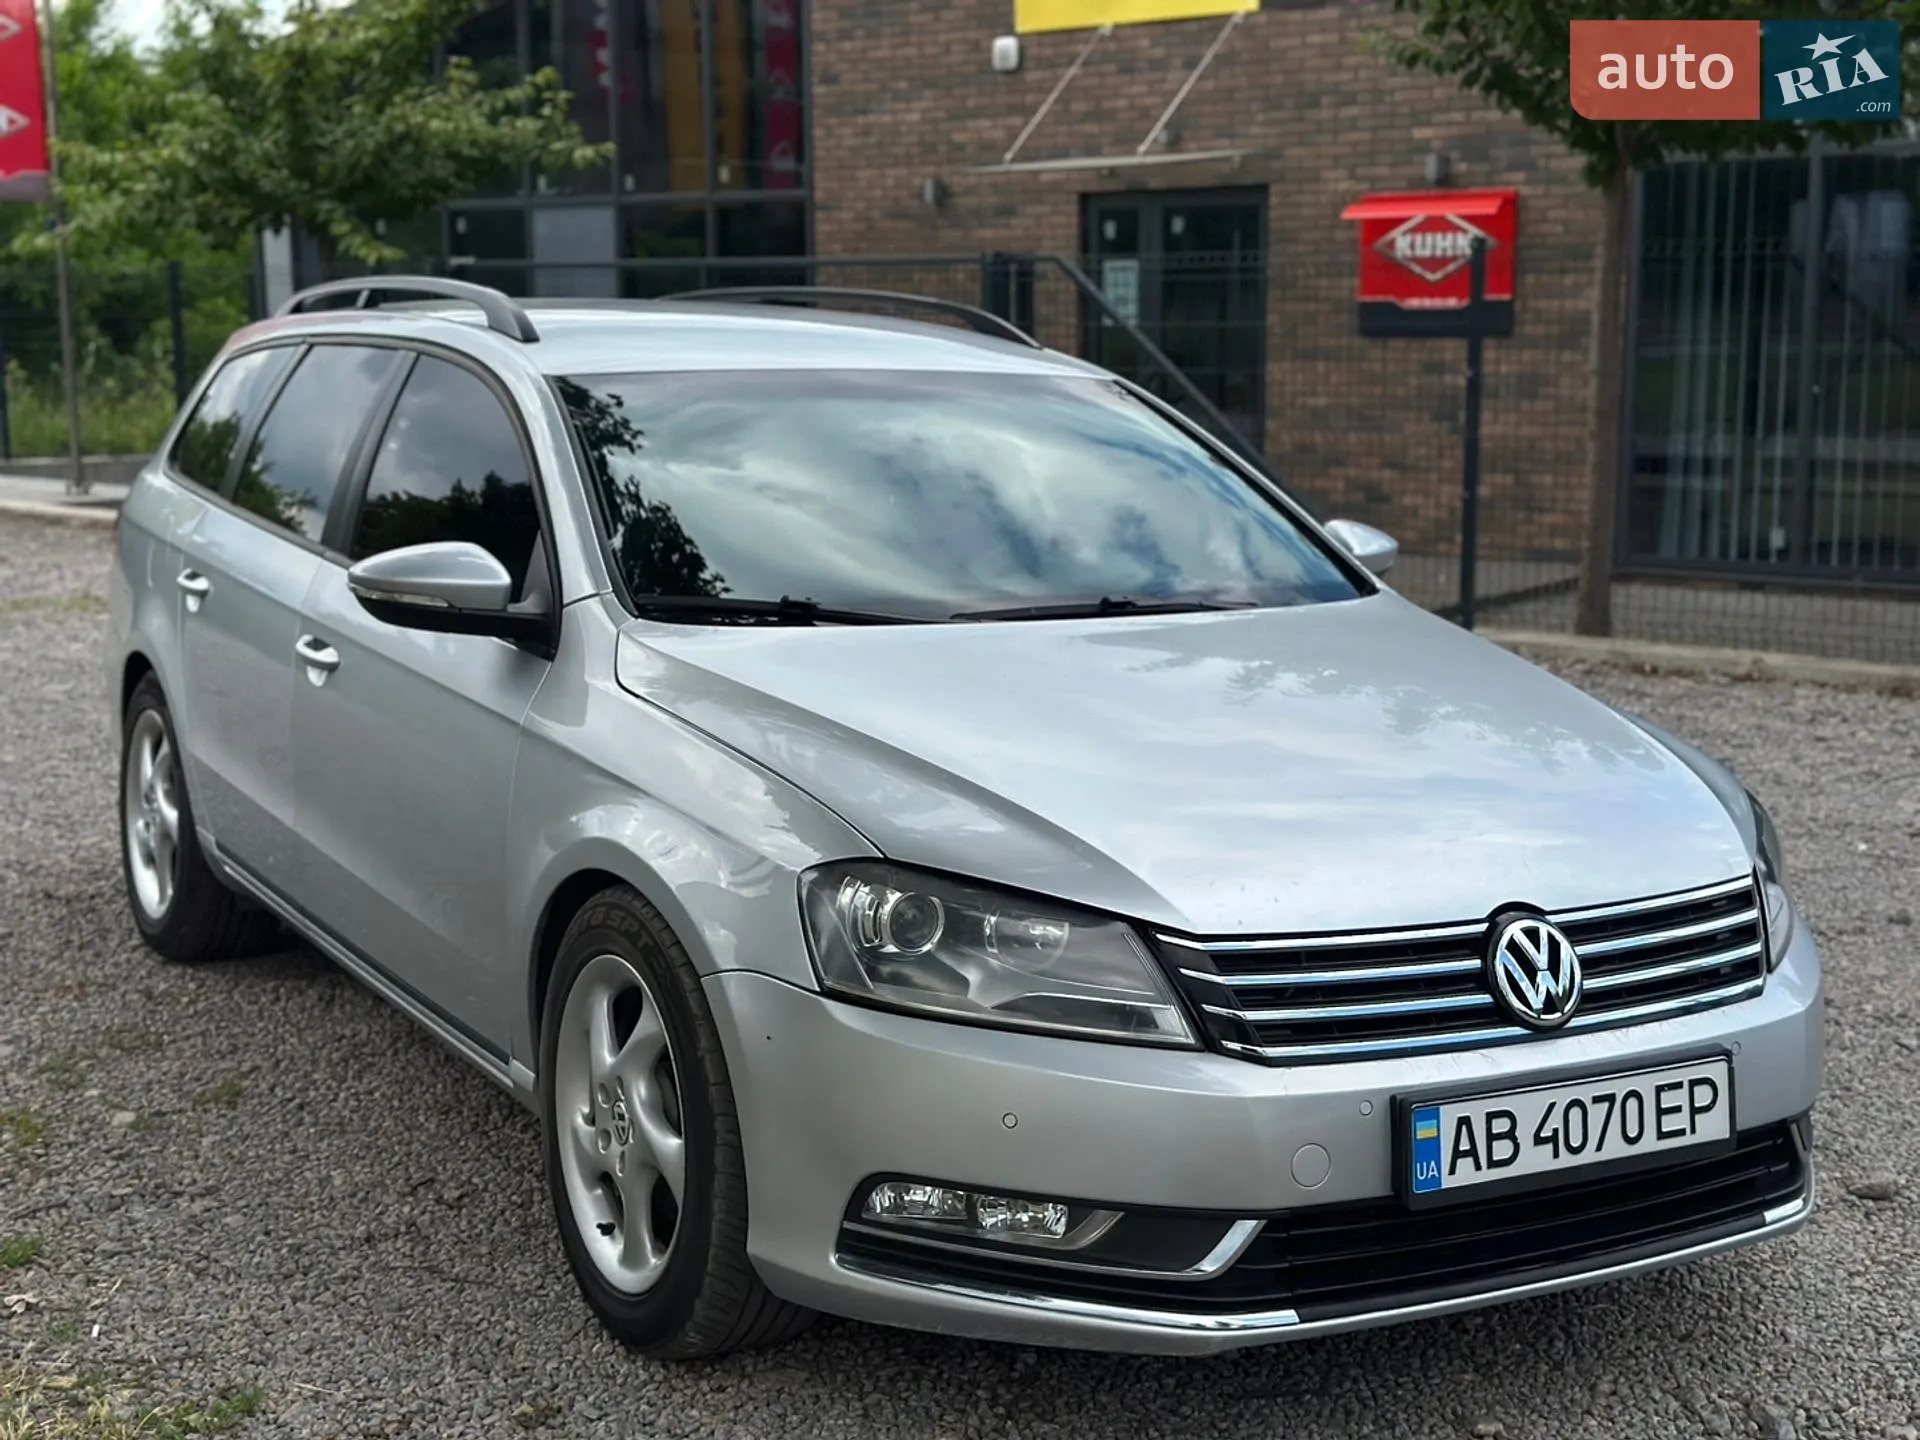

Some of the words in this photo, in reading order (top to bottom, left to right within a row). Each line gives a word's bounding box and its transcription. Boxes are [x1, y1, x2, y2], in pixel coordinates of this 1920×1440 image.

[1448, 1108, 1520, 1176] AB
[1533, 1088, 1645, 1160] 4070
[1654, 1074, 1719, 1141] EP
[1416, 1160, 1440, 1181] UA
